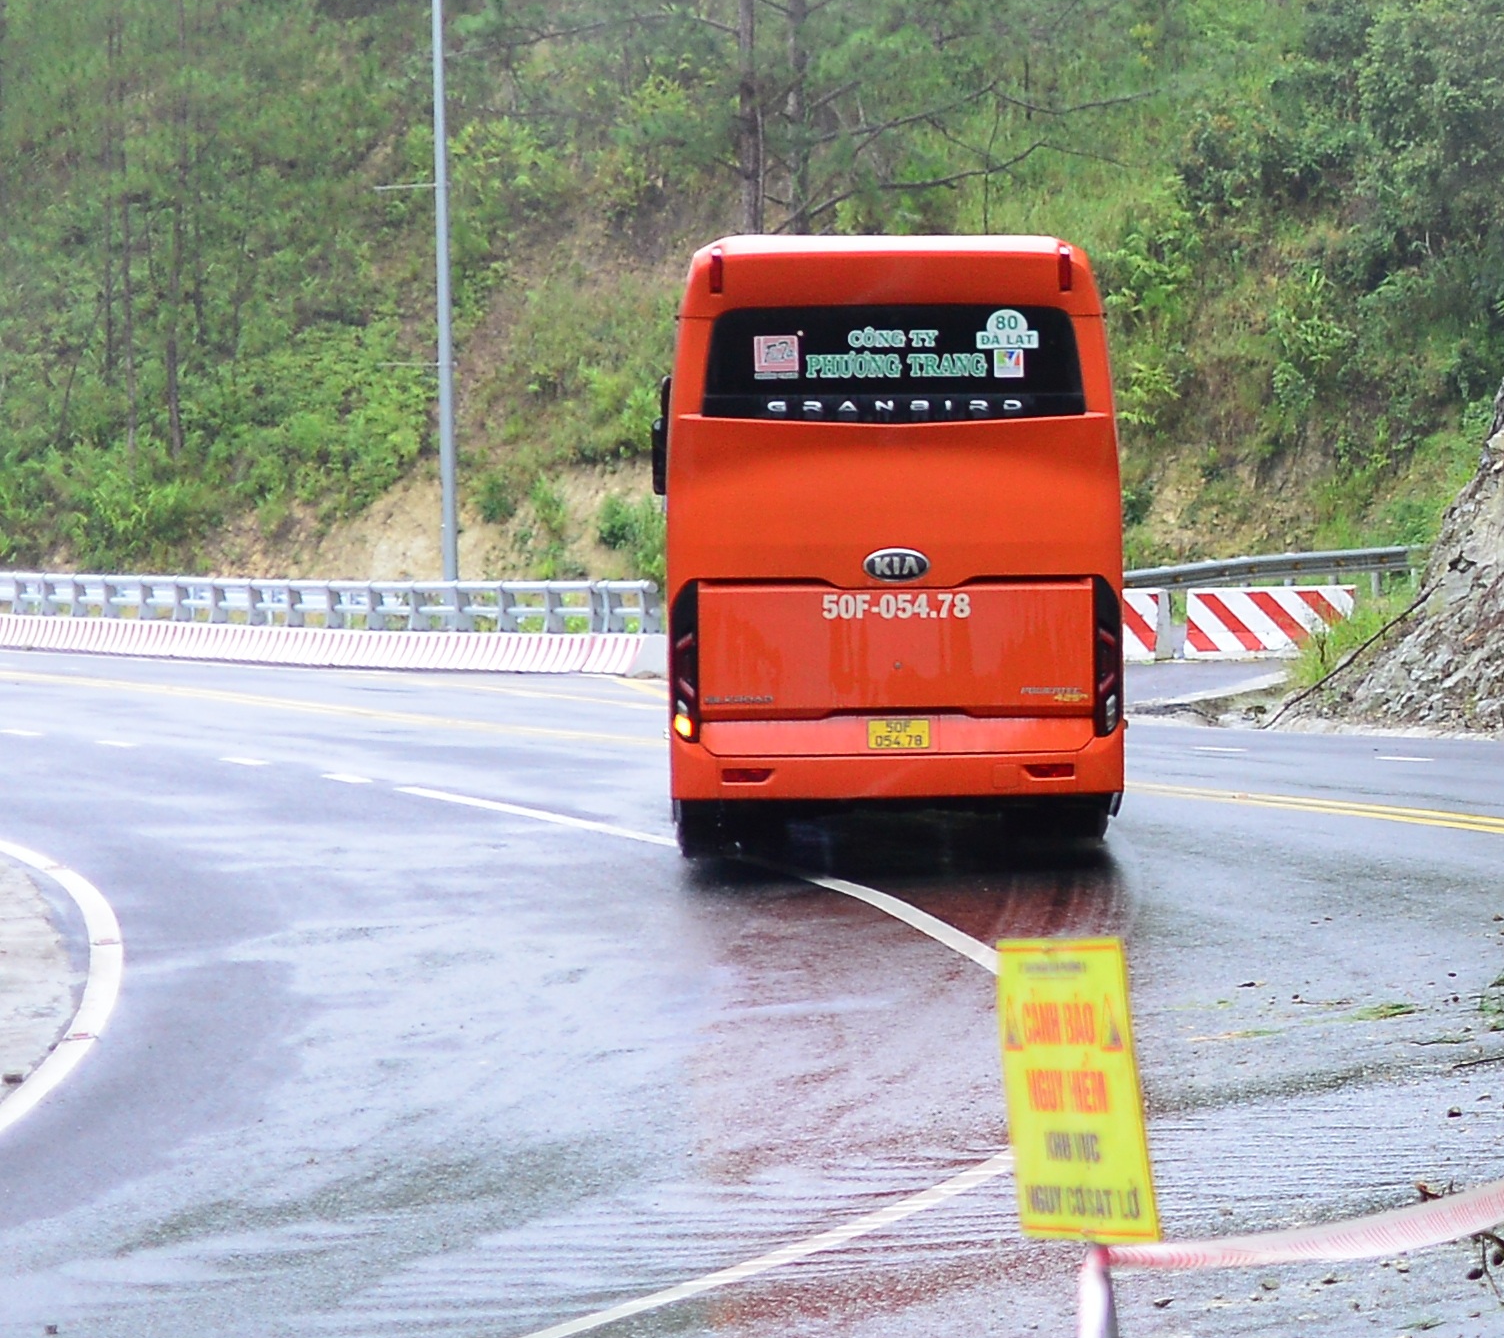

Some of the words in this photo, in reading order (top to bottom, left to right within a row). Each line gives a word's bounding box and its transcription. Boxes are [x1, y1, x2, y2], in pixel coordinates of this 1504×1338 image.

[995, 314, 1019, 331] 80
[848, 326, 906, 348] CÔNG
[908, 329, 939, 348] TY
[981, 332, 1001, 345] ĐÀ
[1007, 333, 1034, 348] LẠT
[806, 351, 903, 379] PHƯƠNG
[907, 352, 988, 378] TRANG
[767, 399, 1023, 412] GRANBIRD
[873, 555, 919, 575] KIA
[822, 592, 971, 620] 50F-054.78
[886, 720, 911, 734] 50F
[875, 734, 922, 747] 054.78
[1026, 1069, 1064, 1112] NGUY
